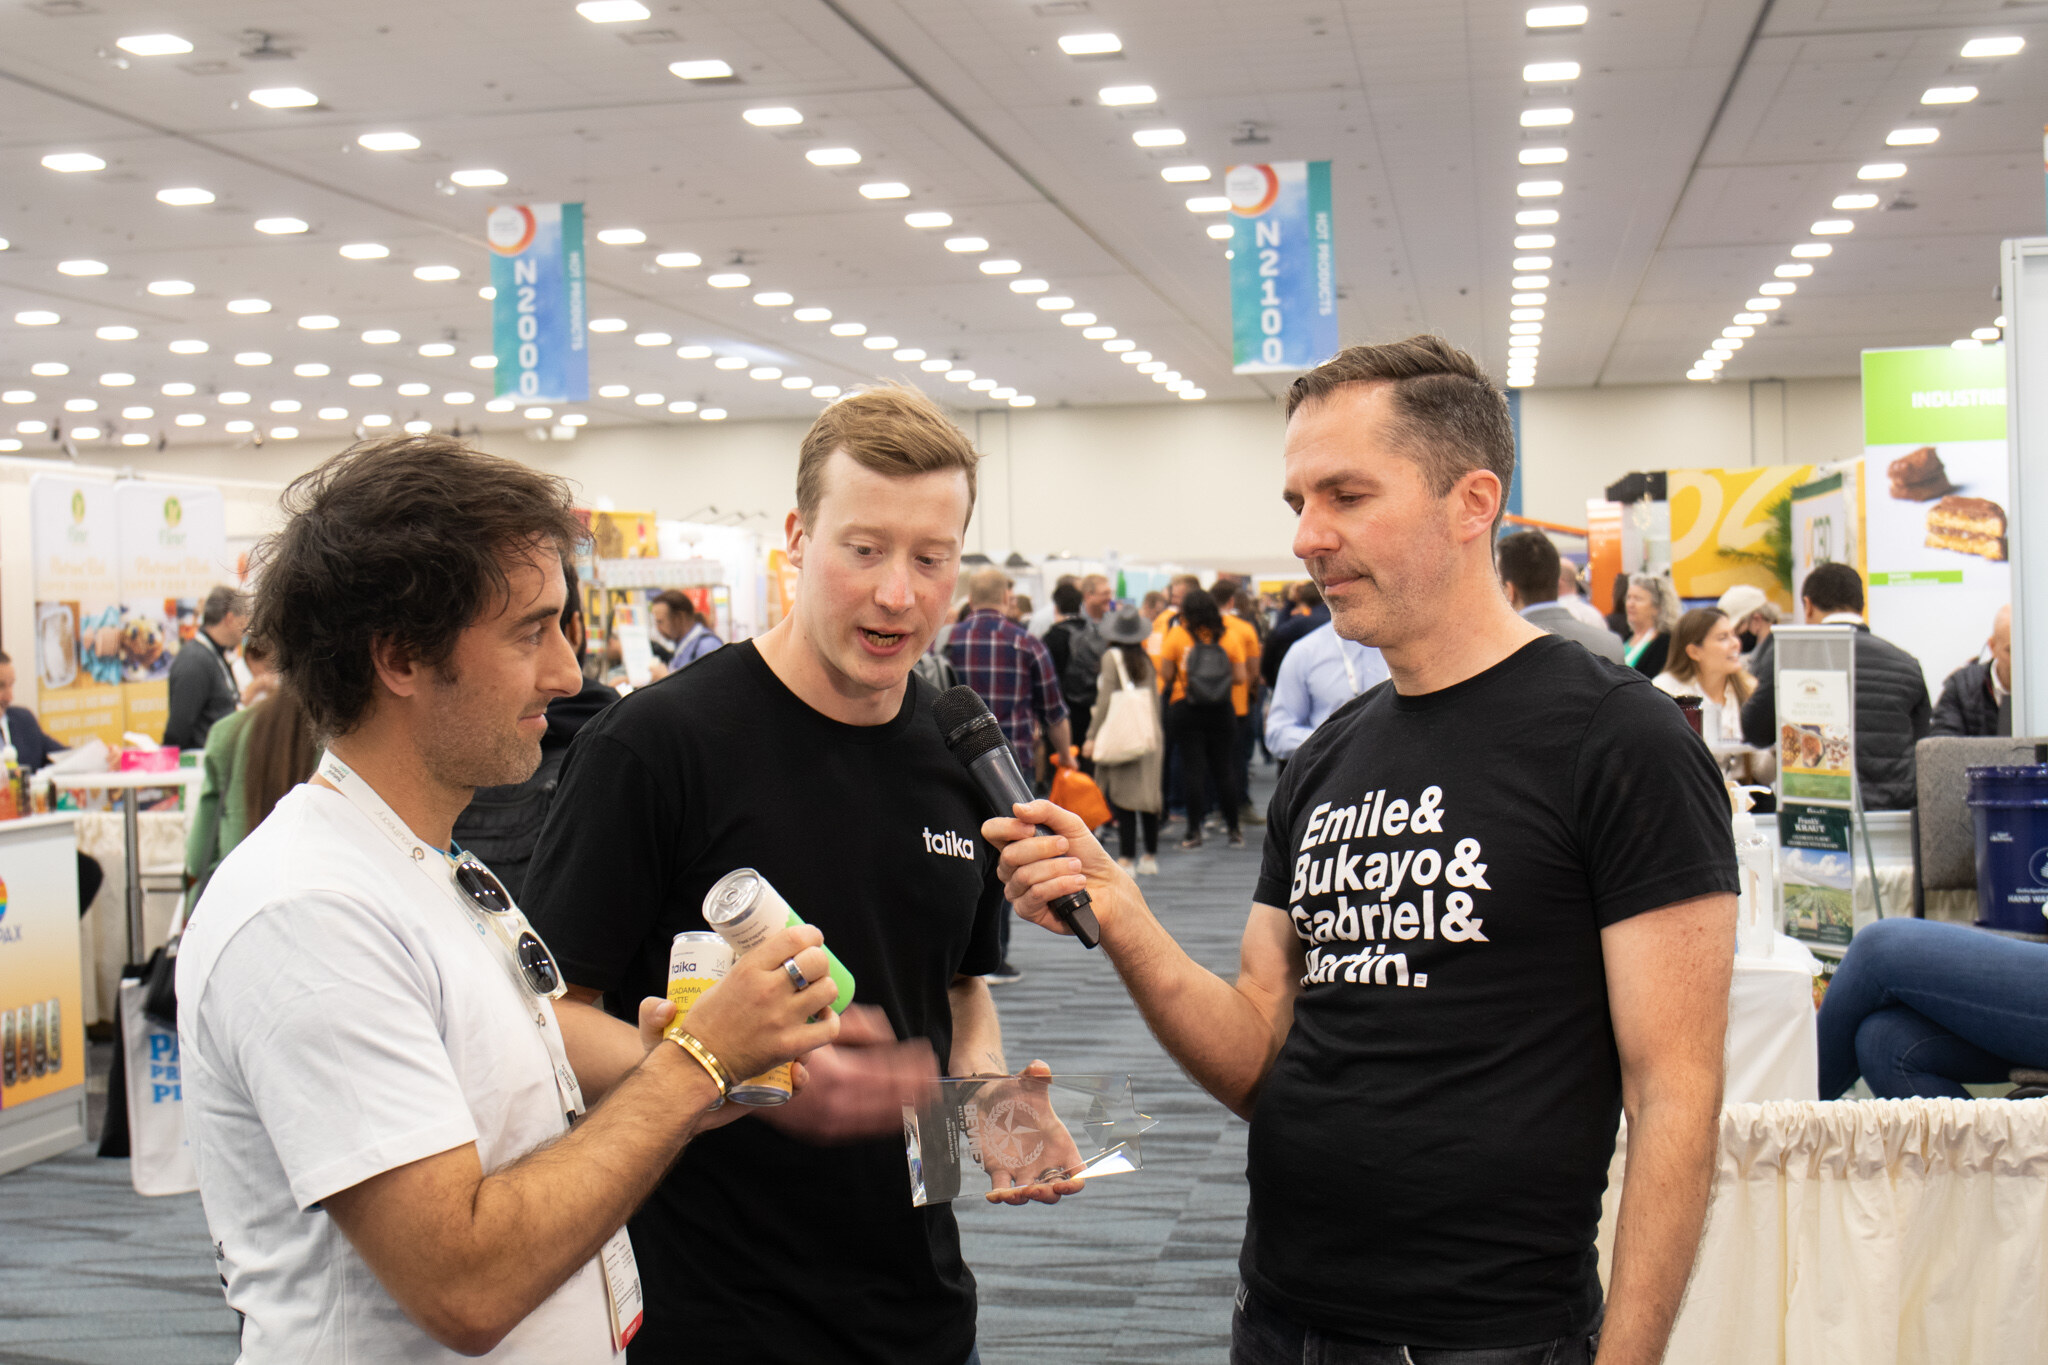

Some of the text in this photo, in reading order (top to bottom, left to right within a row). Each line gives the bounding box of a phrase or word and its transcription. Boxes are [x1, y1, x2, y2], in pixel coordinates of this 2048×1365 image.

[1255, 219, 1283, 364] N2100
[514, 258, 539, 396] N2000
[1299, 785, 1445, 852] Emile&
[922, 826, 974, 860] taika
[1290, 838, 1492, 904] Bukayo&
[2007, 894, 2032, 904] HAND
[672, 961, 697, 975] taika
[667, 986, 702, 997] ACADAMIA
[672, 996, 689, 1005] ATTE
